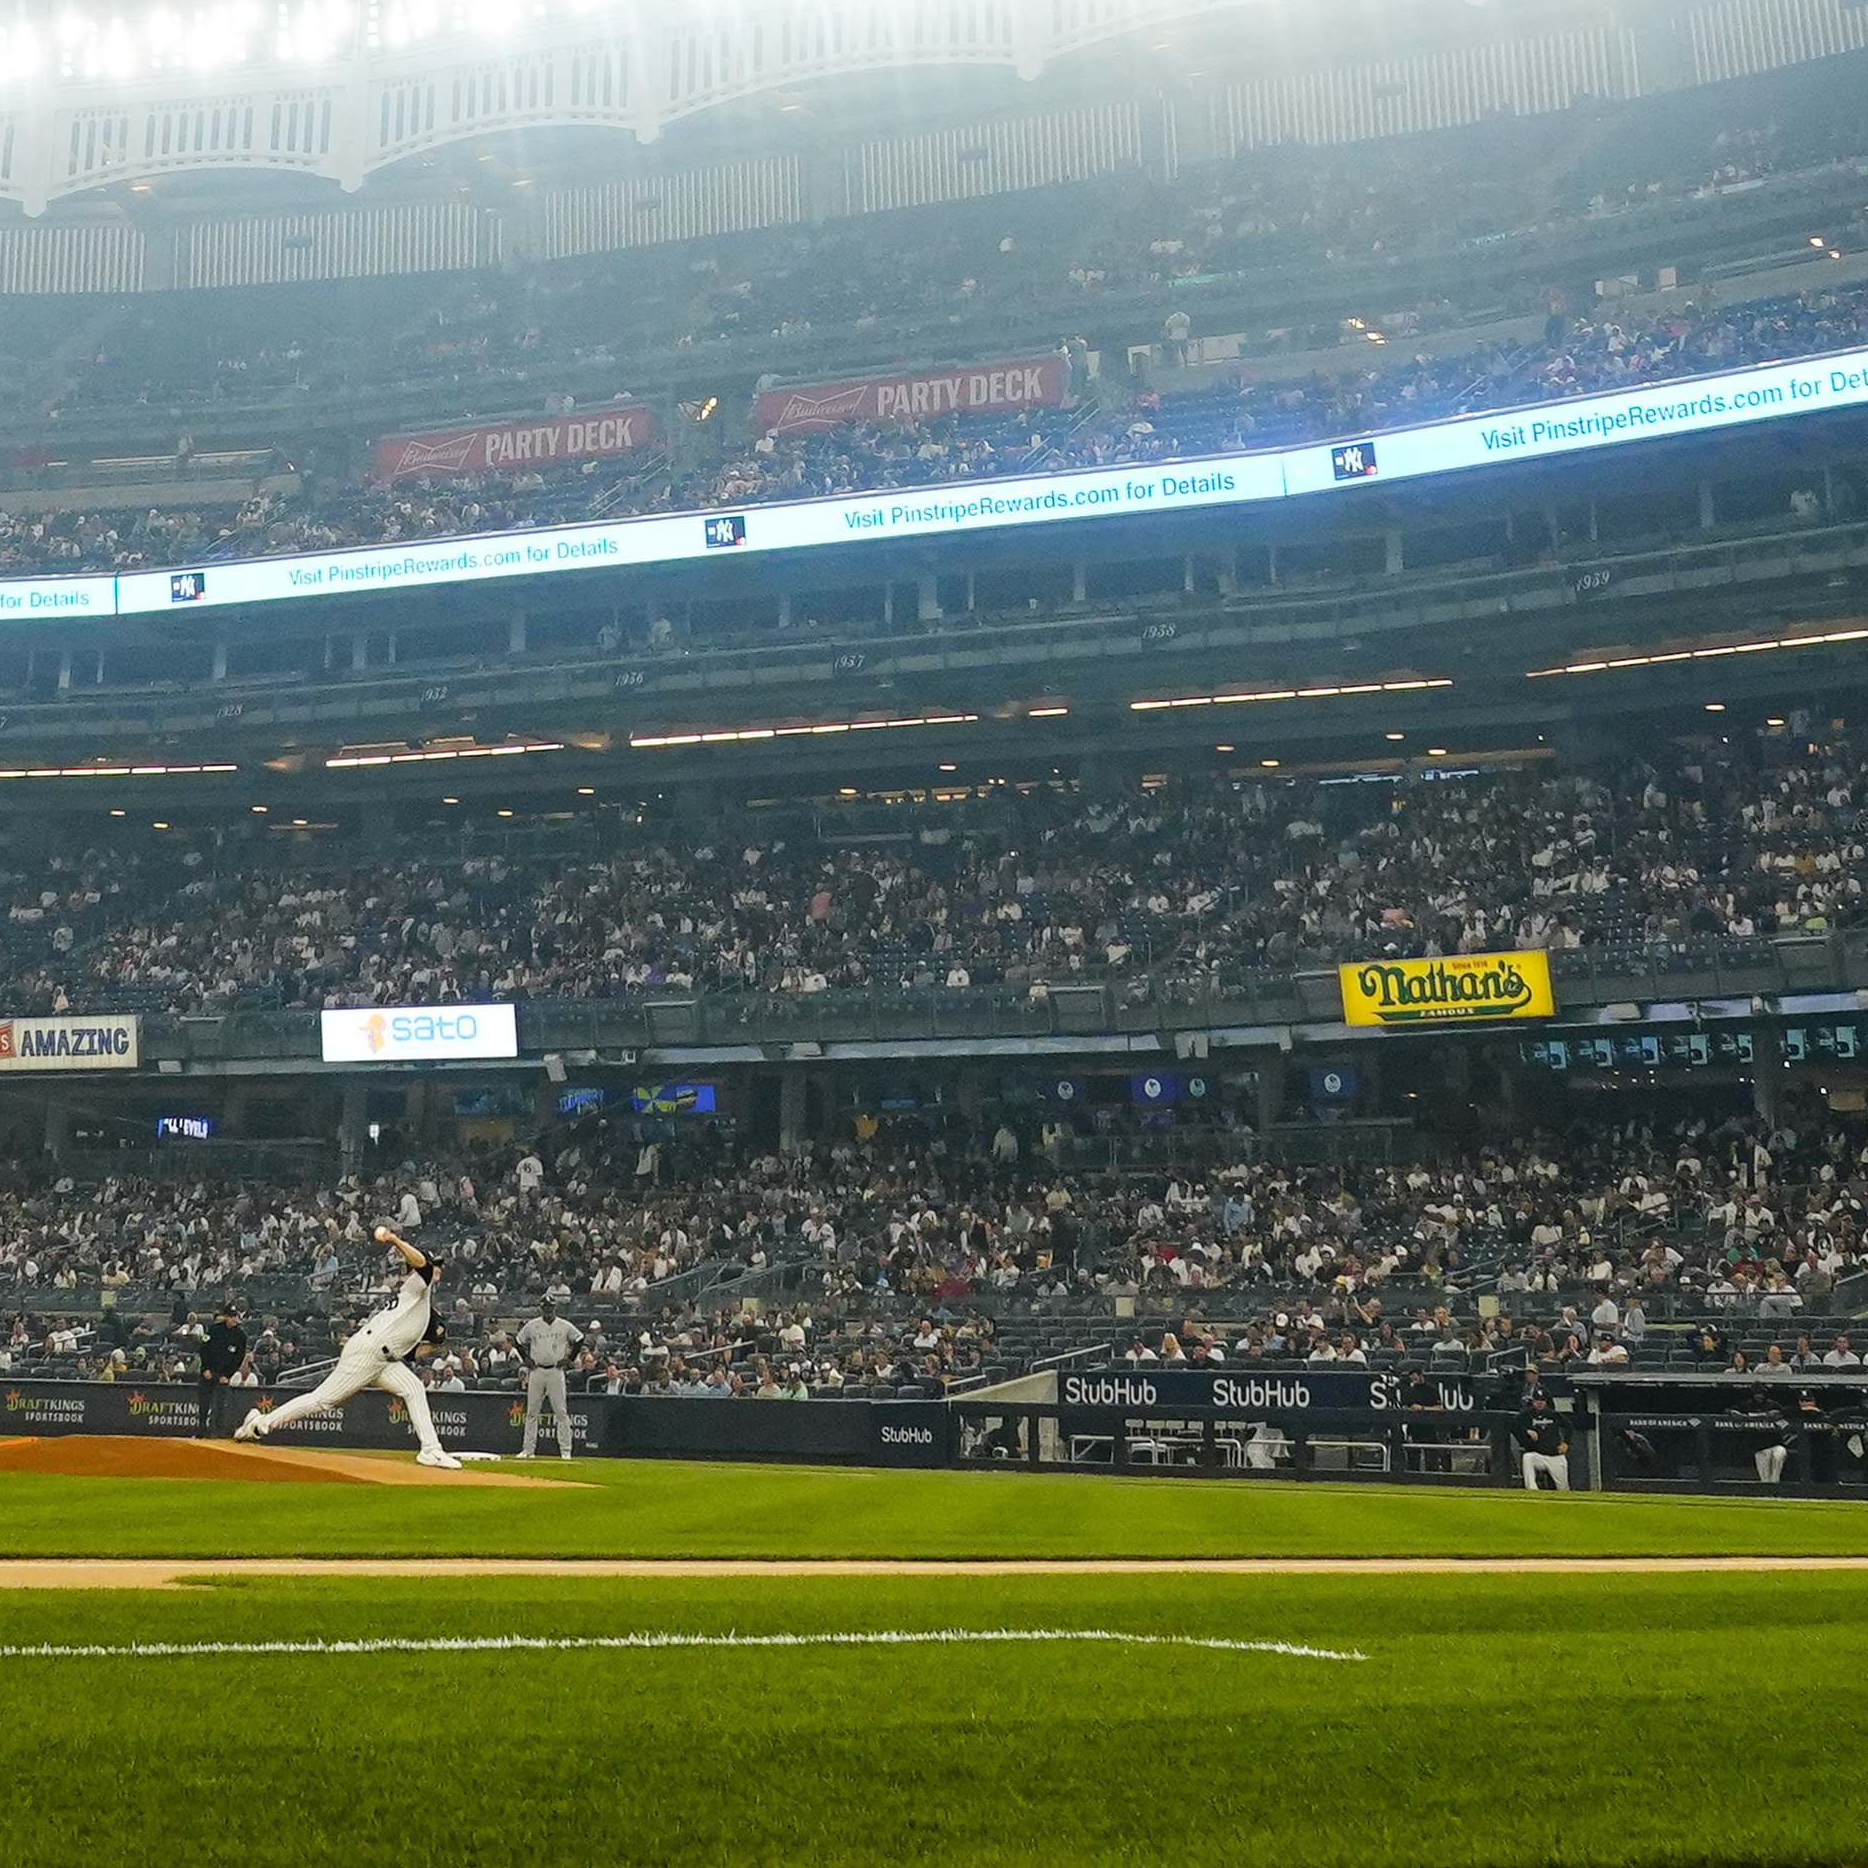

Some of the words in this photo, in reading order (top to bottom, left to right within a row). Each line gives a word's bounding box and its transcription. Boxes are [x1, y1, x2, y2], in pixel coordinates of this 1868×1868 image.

[877, 377, 963, 416] PARTY
[969, 366, 1044, 406] DECK
[1481, 425, 1527, 451] Visit
[1531, 385, 1783, 443] PinstripeRewards.com
[1789, 376, 1824, 399] for
[486, 426, 561, 465] PARTY
[567, 417, 633, 454] DECK
[845, 509, 884, 531] Visit
[891, 484, 1119, 525] PinstripeRewards.com
[1125, 478, 1154, 500] for
[1162, 472, 1235, 496] Details
[289, 566, 323, 587] Visit
[328, 547, 521, 584] PinstripeRewards.com
[526, 544, 550, 563] for
[556, 537, 618, 559] Details
[0, 591, 24, 609] for
[29, 589, 90, 610] Details
[1358, 959, 1531, 1007] Nathan's
[21, 1027, 129, 1057] AMAZING
[392, 1014, 477, 1042] sato
[6, 1396, 85, 1412] DRAFTKINGS
[1065, 1376, 1158, 1405] StubHub
[1212, 1379, 1311, 1408] StubHub
[24, 1411, 84, 1423] SPORTSBOOK
[881, 1425, 932, 1443] StubHub
